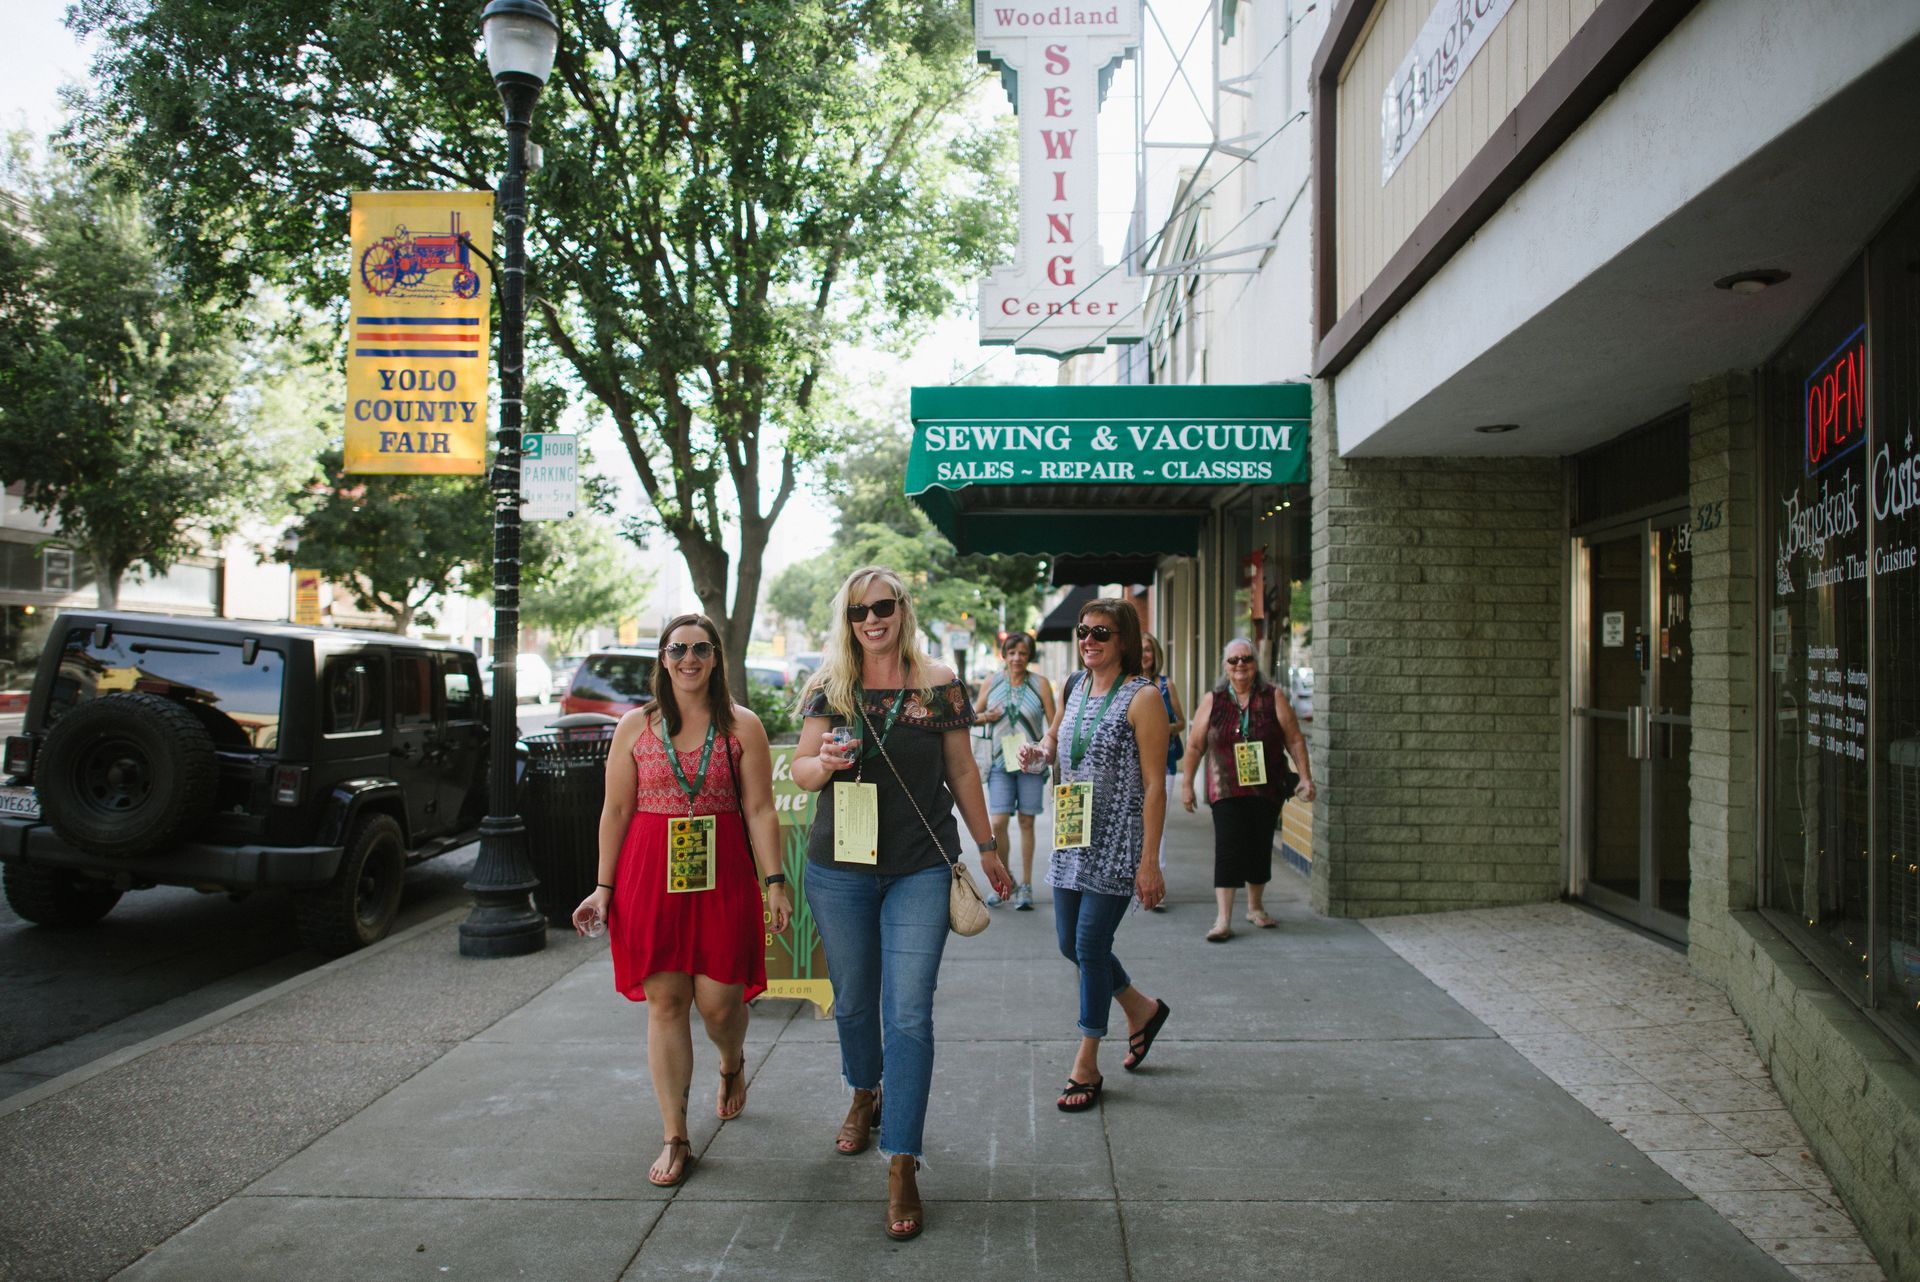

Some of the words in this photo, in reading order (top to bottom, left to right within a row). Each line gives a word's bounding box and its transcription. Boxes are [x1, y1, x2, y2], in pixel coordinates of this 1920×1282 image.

[995, 6, 1119, 27] Woodland
[1040, 44, 1078, 287] SEWING
[1002, 297, 1119, 317] Center
[378, 369, 456, 391] YOLO
[354, 400, 478, 423] COUNTY
[1808, 342, 1864, 464] OPEN
[378, 431, 450, 454] FAIR
[525, 437, 538, 456] 2
[544, 443, 573, 456] HOUR
[925, 425, 1071, 452] SEWING
[1090, 424, 1117, 451] &
[1127, 424, 1292, 451] VACUUM
[524, 467, 574, 482] PARKING
[937, 461, 1014, 481] SALES
[1039, 461, 1135, 480] REPAIR
[1161, 460, 1272, 480] CLASSES
[1697, 501, 1725, 531] 525
[1781, 467, 1860, 560] Bangkok
[1807, 558, 1844, 589] Authentic
[1846, 550, 1868, 581] Thai
[1875, 540, 1917, 575] Cuisine
[1847, 668, 1868, 689] Saturday
[1847, 692, 1866, 716] Monday
